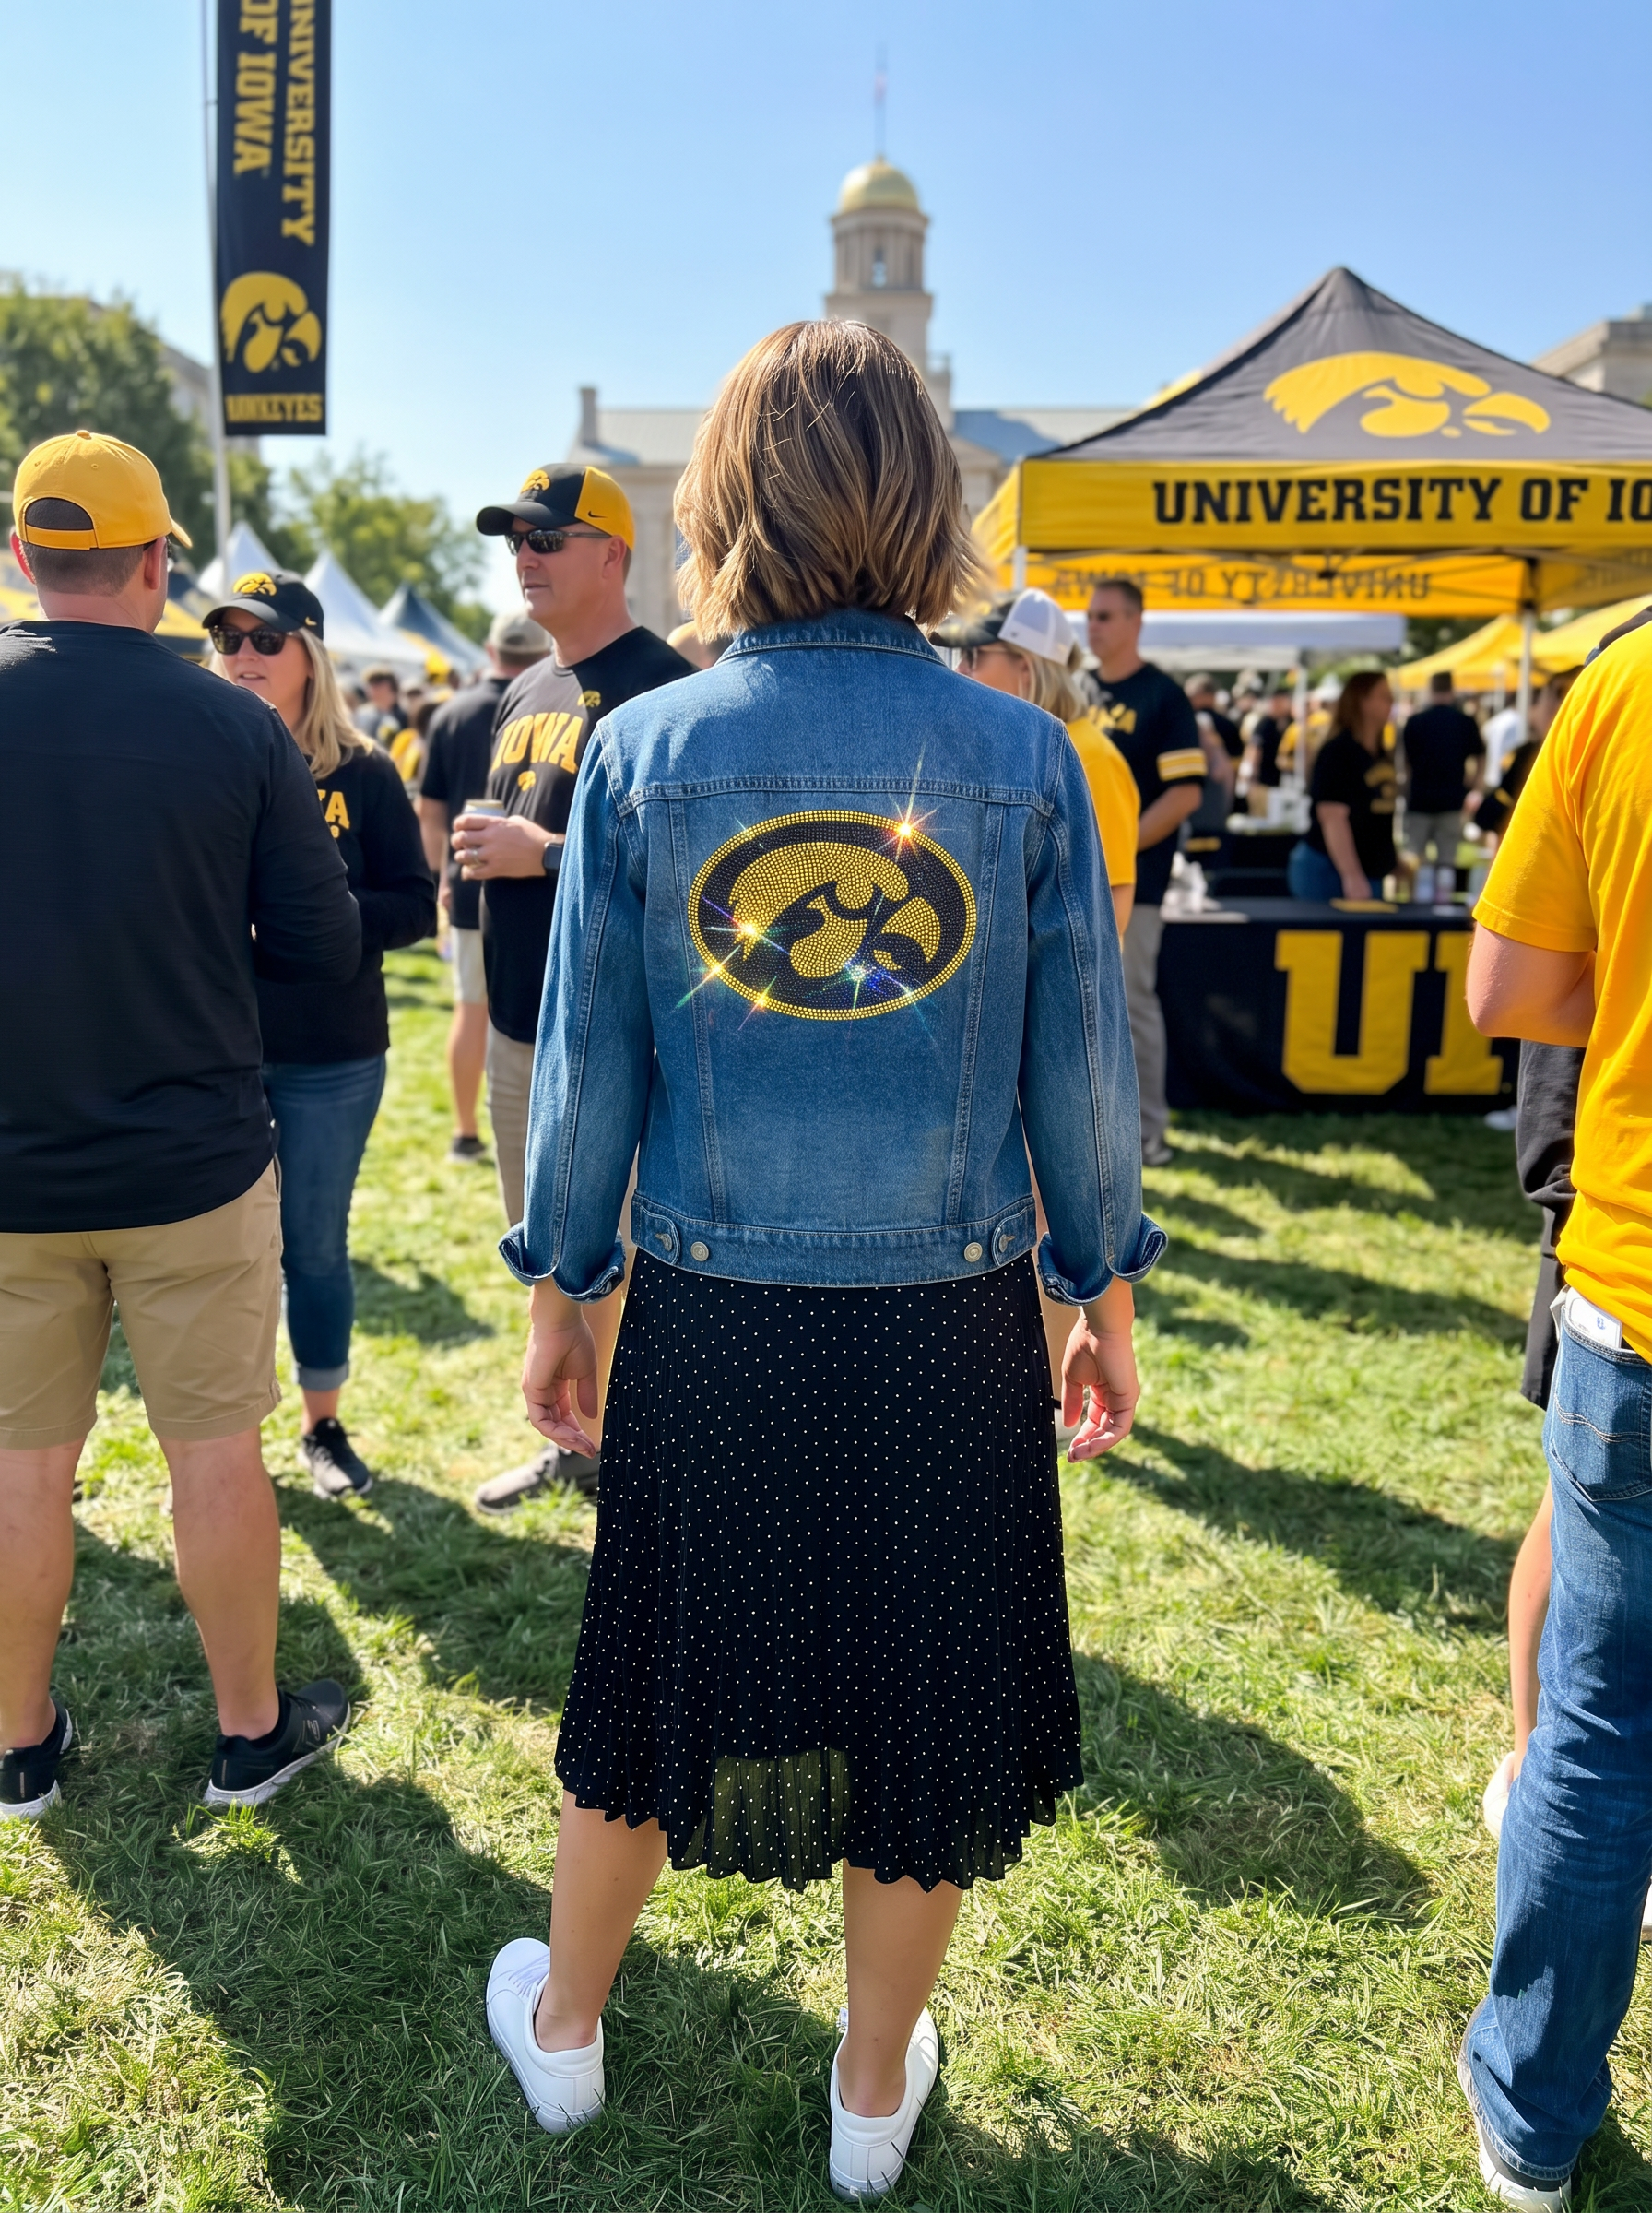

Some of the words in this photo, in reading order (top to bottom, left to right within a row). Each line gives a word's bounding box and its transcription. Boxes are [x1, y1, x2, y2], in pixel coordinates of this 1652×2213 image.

[233, 52, 276, 174] IOWA
[281, 0, 315, 246] NIVERSITY
[1152, 477, 1502, 524] UNIVERSITY
[1520, 478, 1589, 521] OF
[490, 711, 584, 775] IOWA
